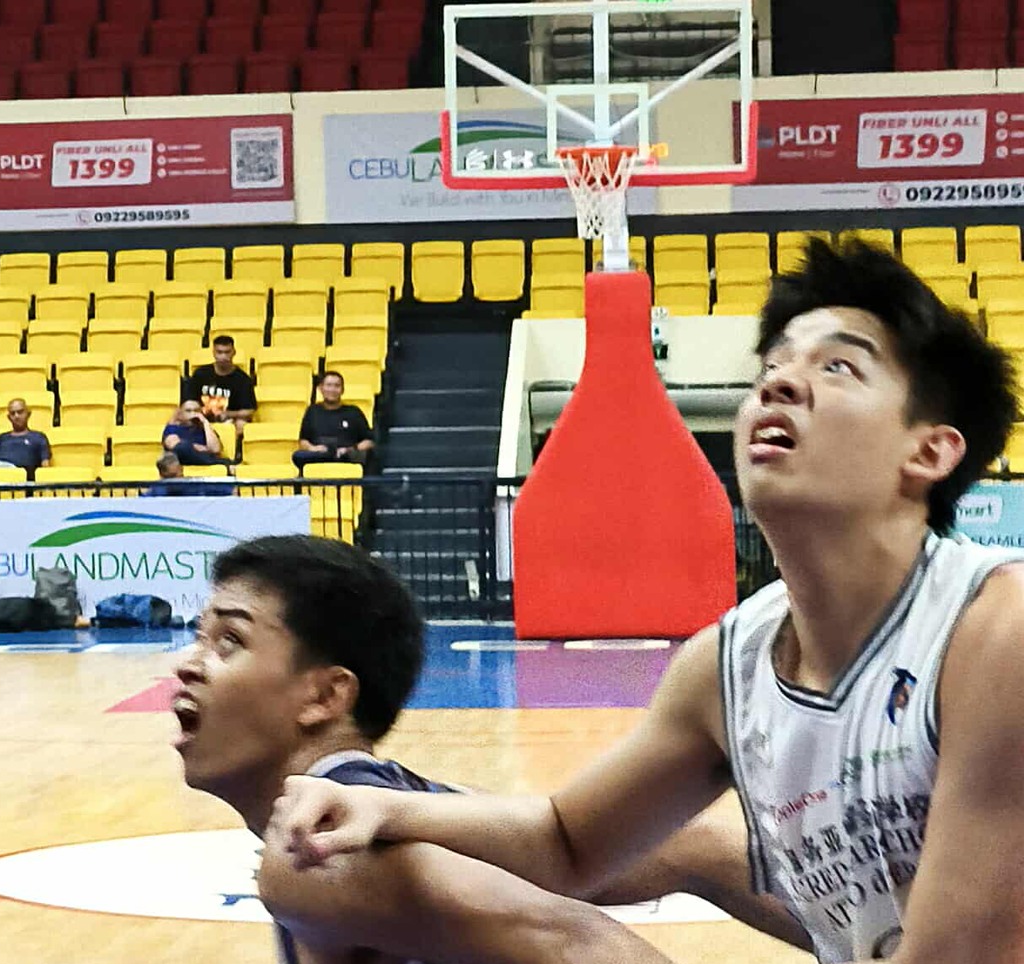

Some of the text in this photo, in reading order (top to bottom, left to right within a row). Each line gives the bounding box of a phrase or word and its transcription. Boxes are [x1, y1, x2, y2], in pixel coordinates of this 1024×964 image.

[779, 125, 842, 146] PLDT
[879, 132, 964, 159] 1399
[0, 153, 46, 170] PLDT
[68, 158, 136, 180] 1399
